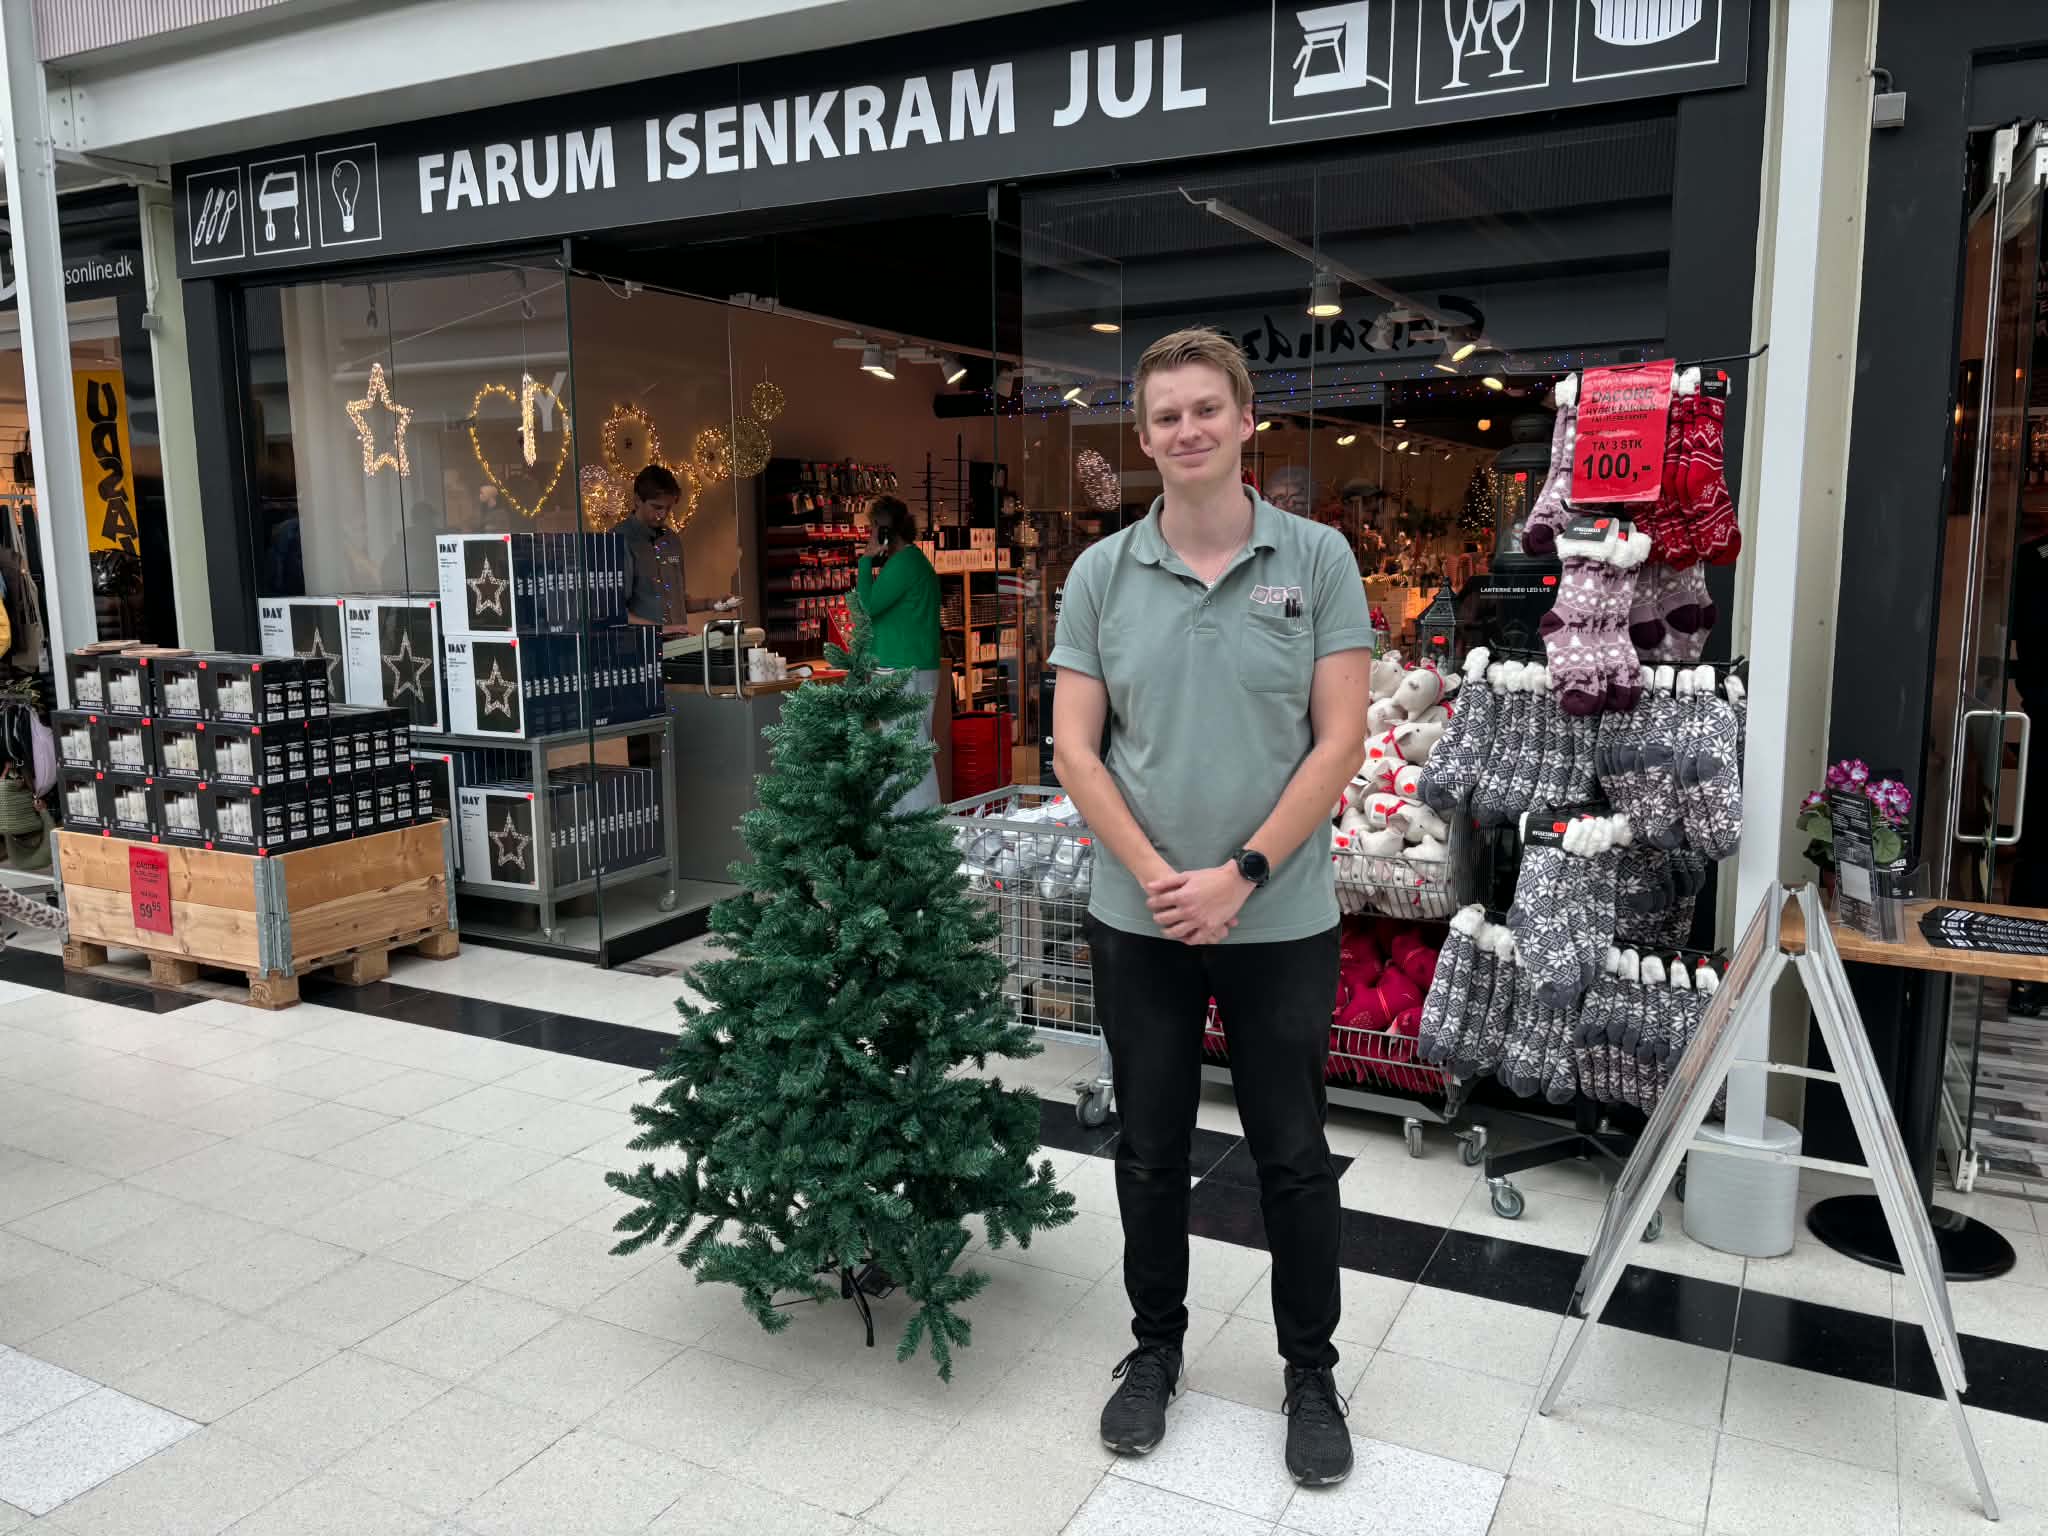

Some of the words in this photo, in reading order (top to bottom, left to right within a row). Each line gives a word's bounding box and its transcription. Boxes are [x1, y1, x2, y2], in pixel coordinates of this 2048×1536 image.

[418, 126, 616, 214] FARUM
[645, 62, 1016, 183] ISENKRAM
[1053, 33, 1207, 128] JUL
[64, 255, 134, 285] sonline.dk
[1620, 439, 1643, 450] STK
[1583, 453, 1651, 482] 100,-
[439, 543, 457, 553] DAY
[263, 607, 283, 619] DAY
[349, 609, 371, 621] DAY
[448, 643, 466, 653] DAY
[462, 795, 480, 805] DAY
